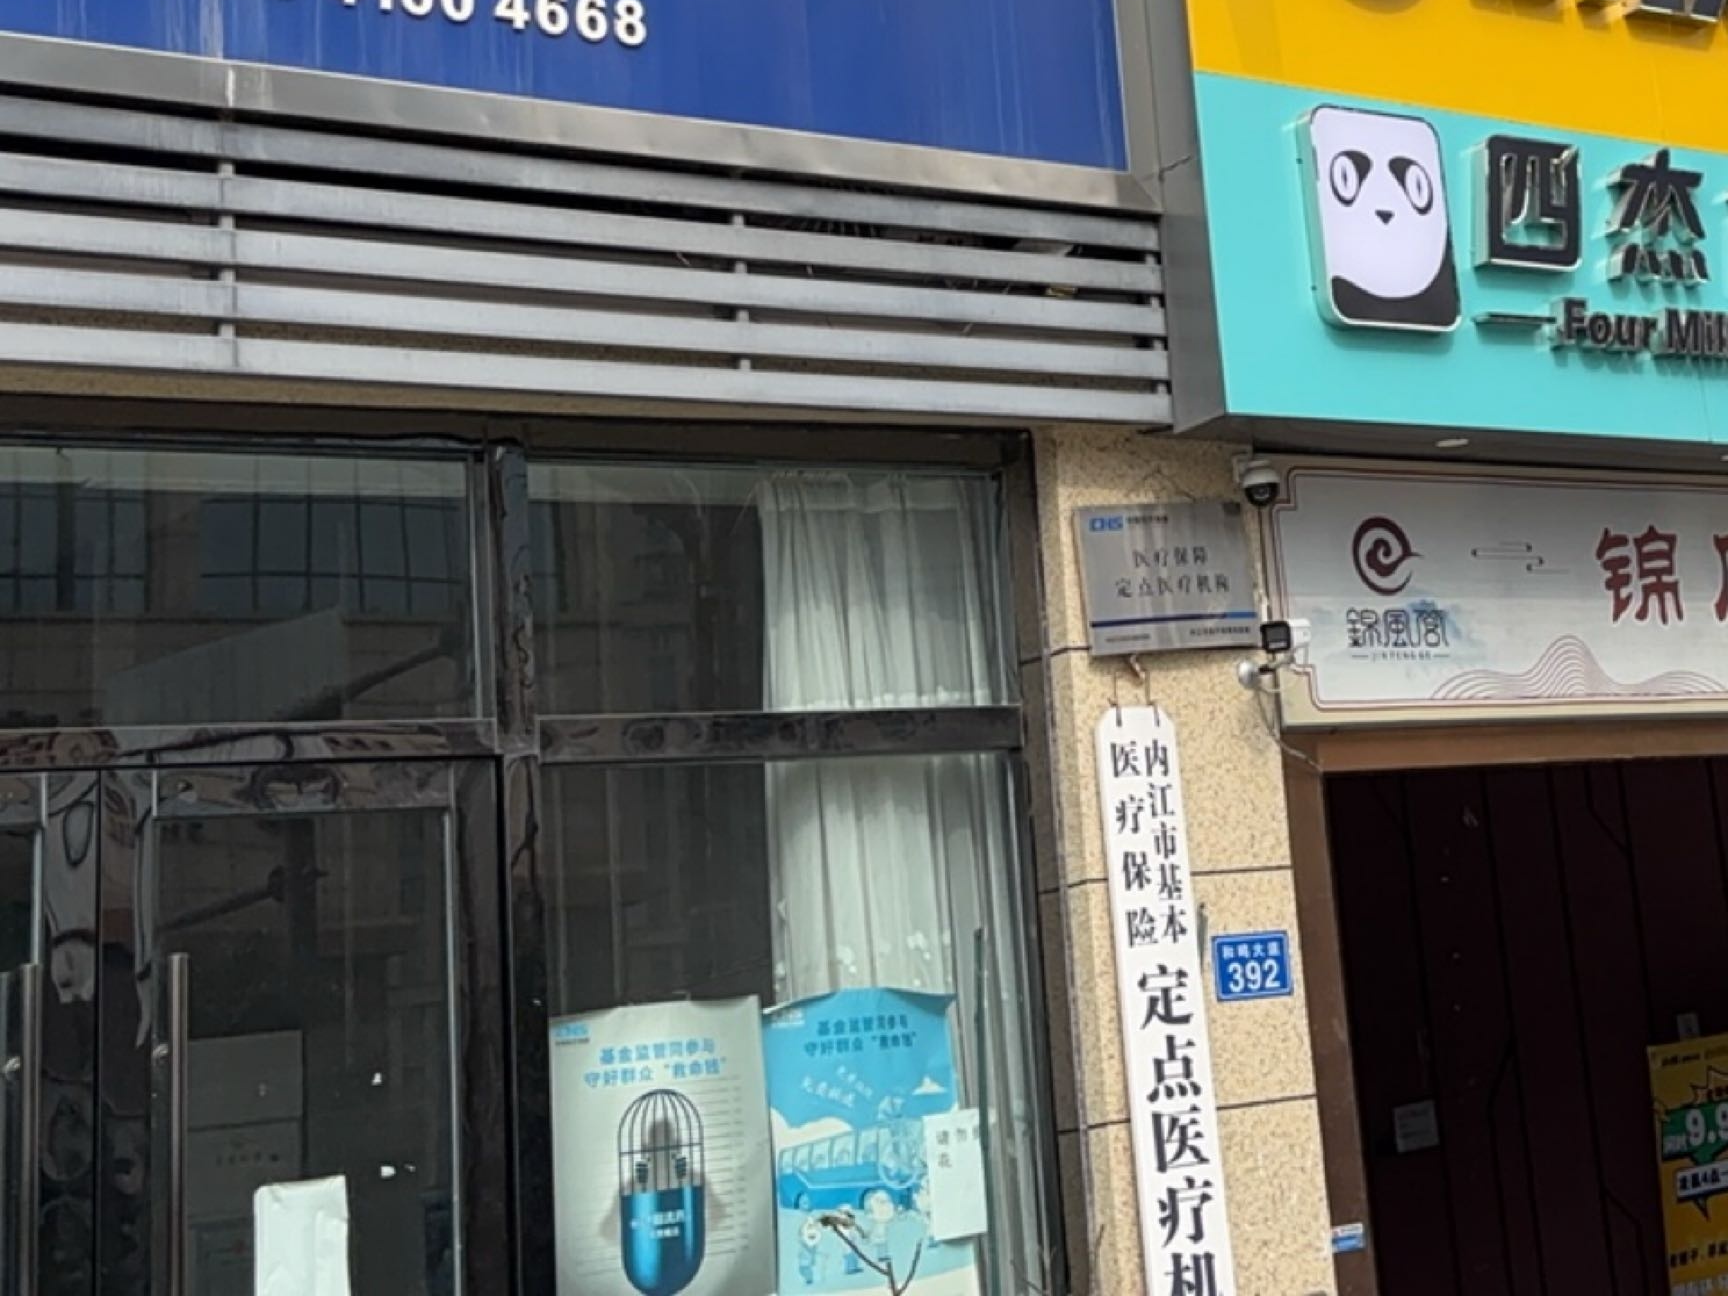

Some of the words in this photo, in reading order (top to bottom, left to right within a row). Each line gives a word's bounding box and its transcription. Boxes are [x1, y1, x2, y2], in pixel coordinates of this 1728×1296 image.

[1556, 296, 1656, 351] Four
[1114, 573, 1232, 599] 定点医疗机构
[1109, 738, 1160, 950] 医疗保险
[1143, 736, 1189, 946] 内江市基本
[1227, 959, 1282, 994] 392
[1136, 963, 1224, 1296] 定点医疗机
